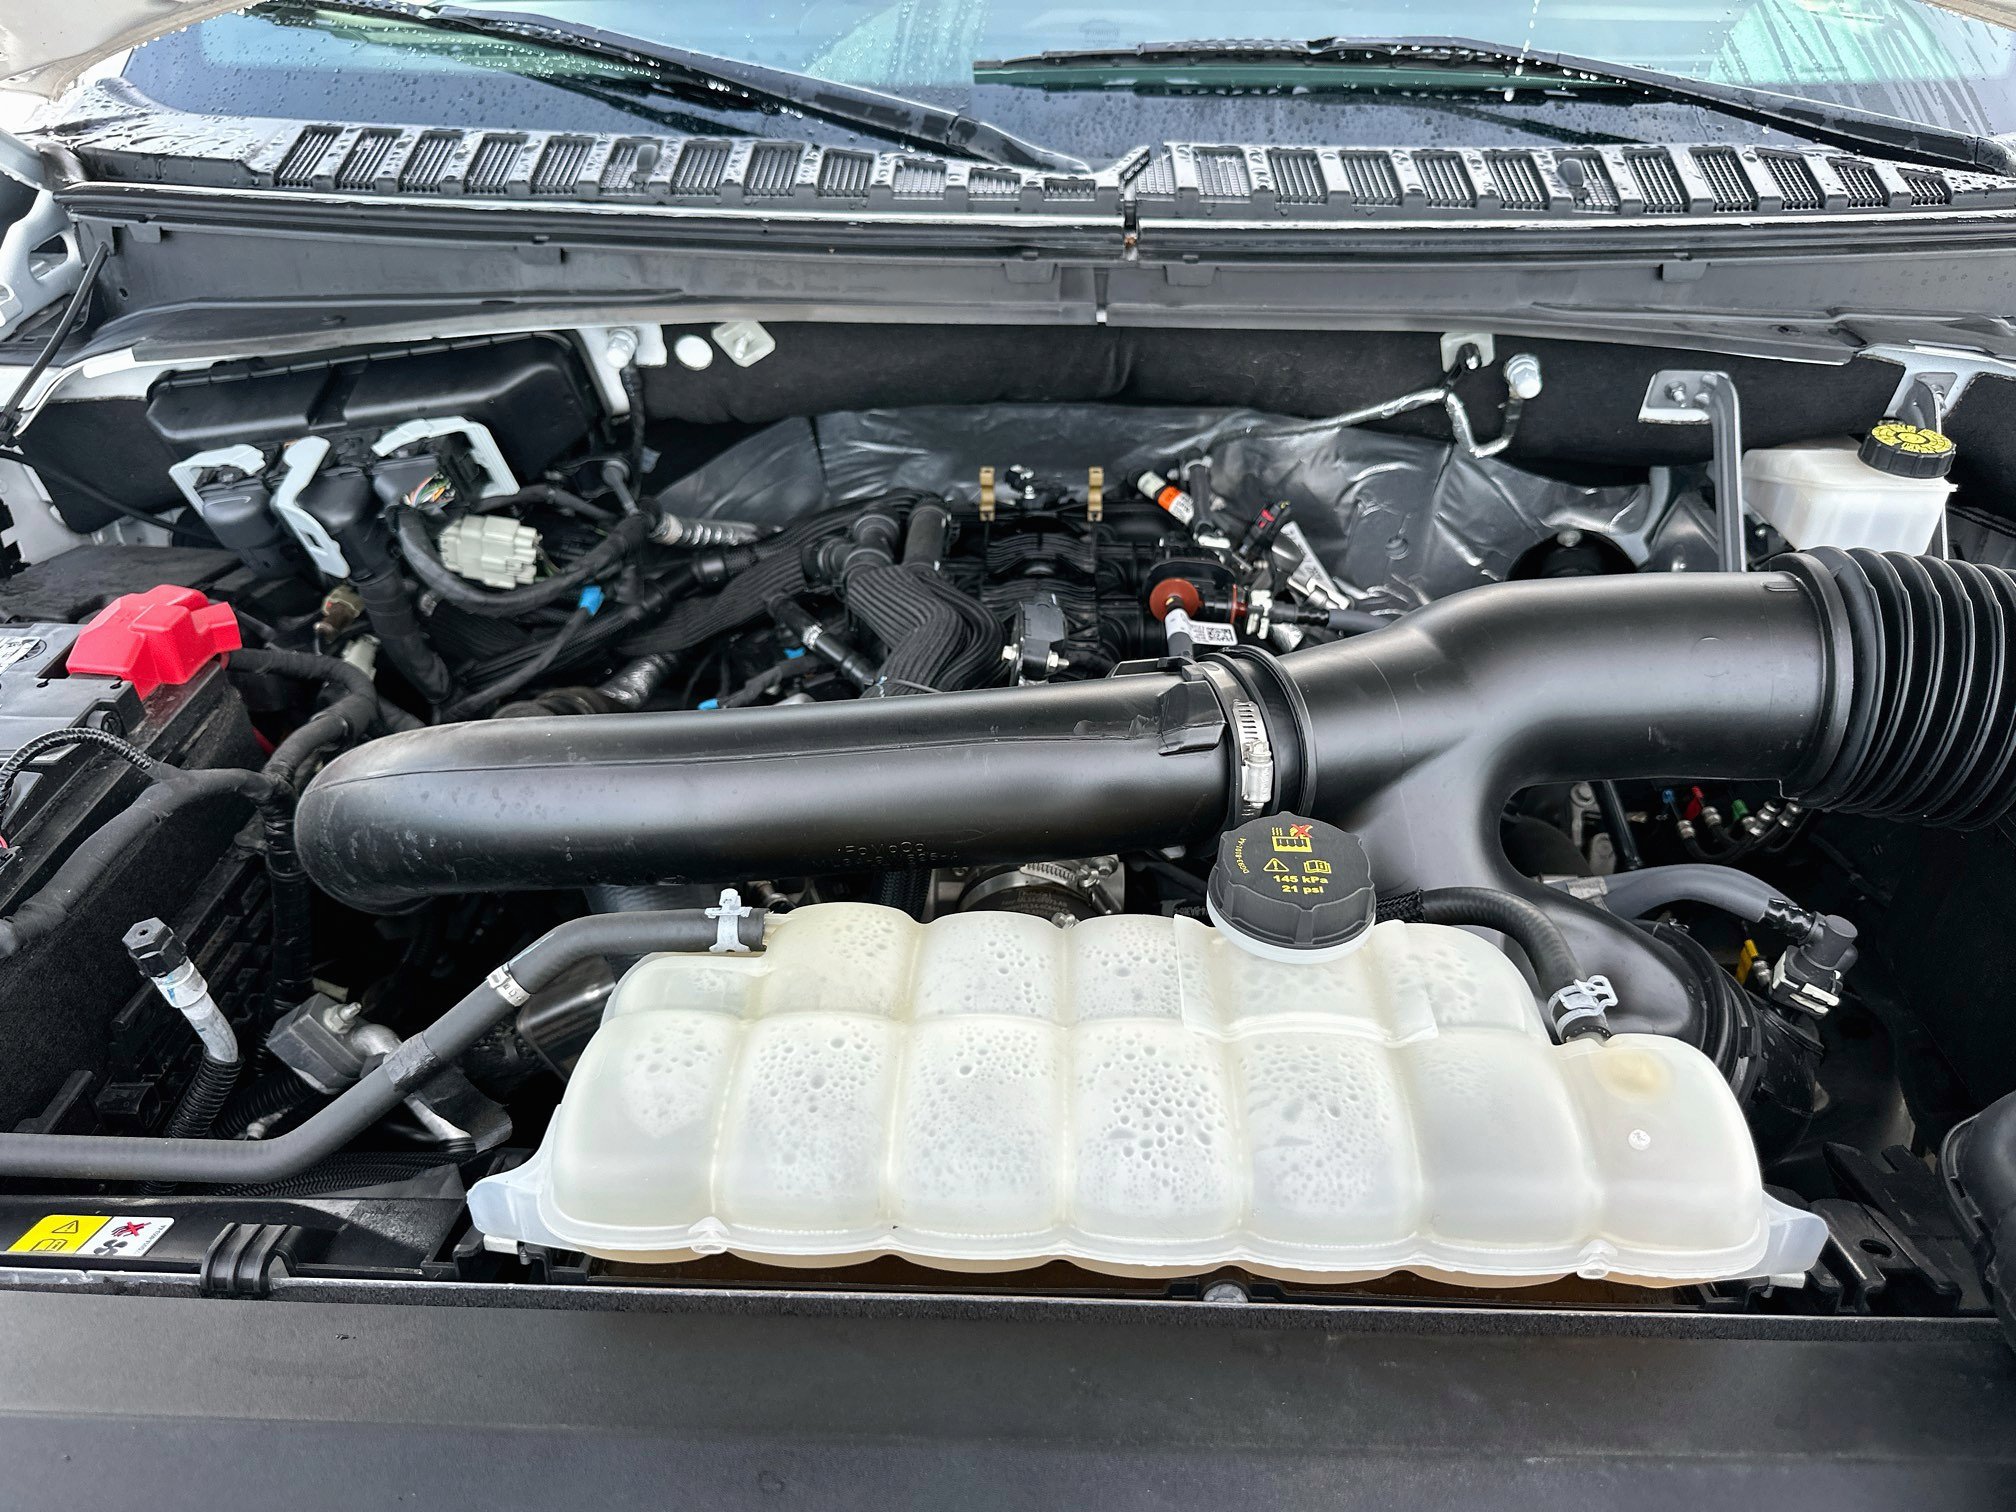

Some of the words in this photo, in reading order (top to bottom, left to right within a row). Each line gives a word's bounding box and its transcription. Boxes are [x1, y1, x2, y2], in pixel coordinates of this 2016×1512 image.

[1273, 874, 1299, 883] 145
[1301, 875, 1329, 884] kPa
[1281, 885, 1299, 893] 21
[1302, 886, 1324, 896] psi
